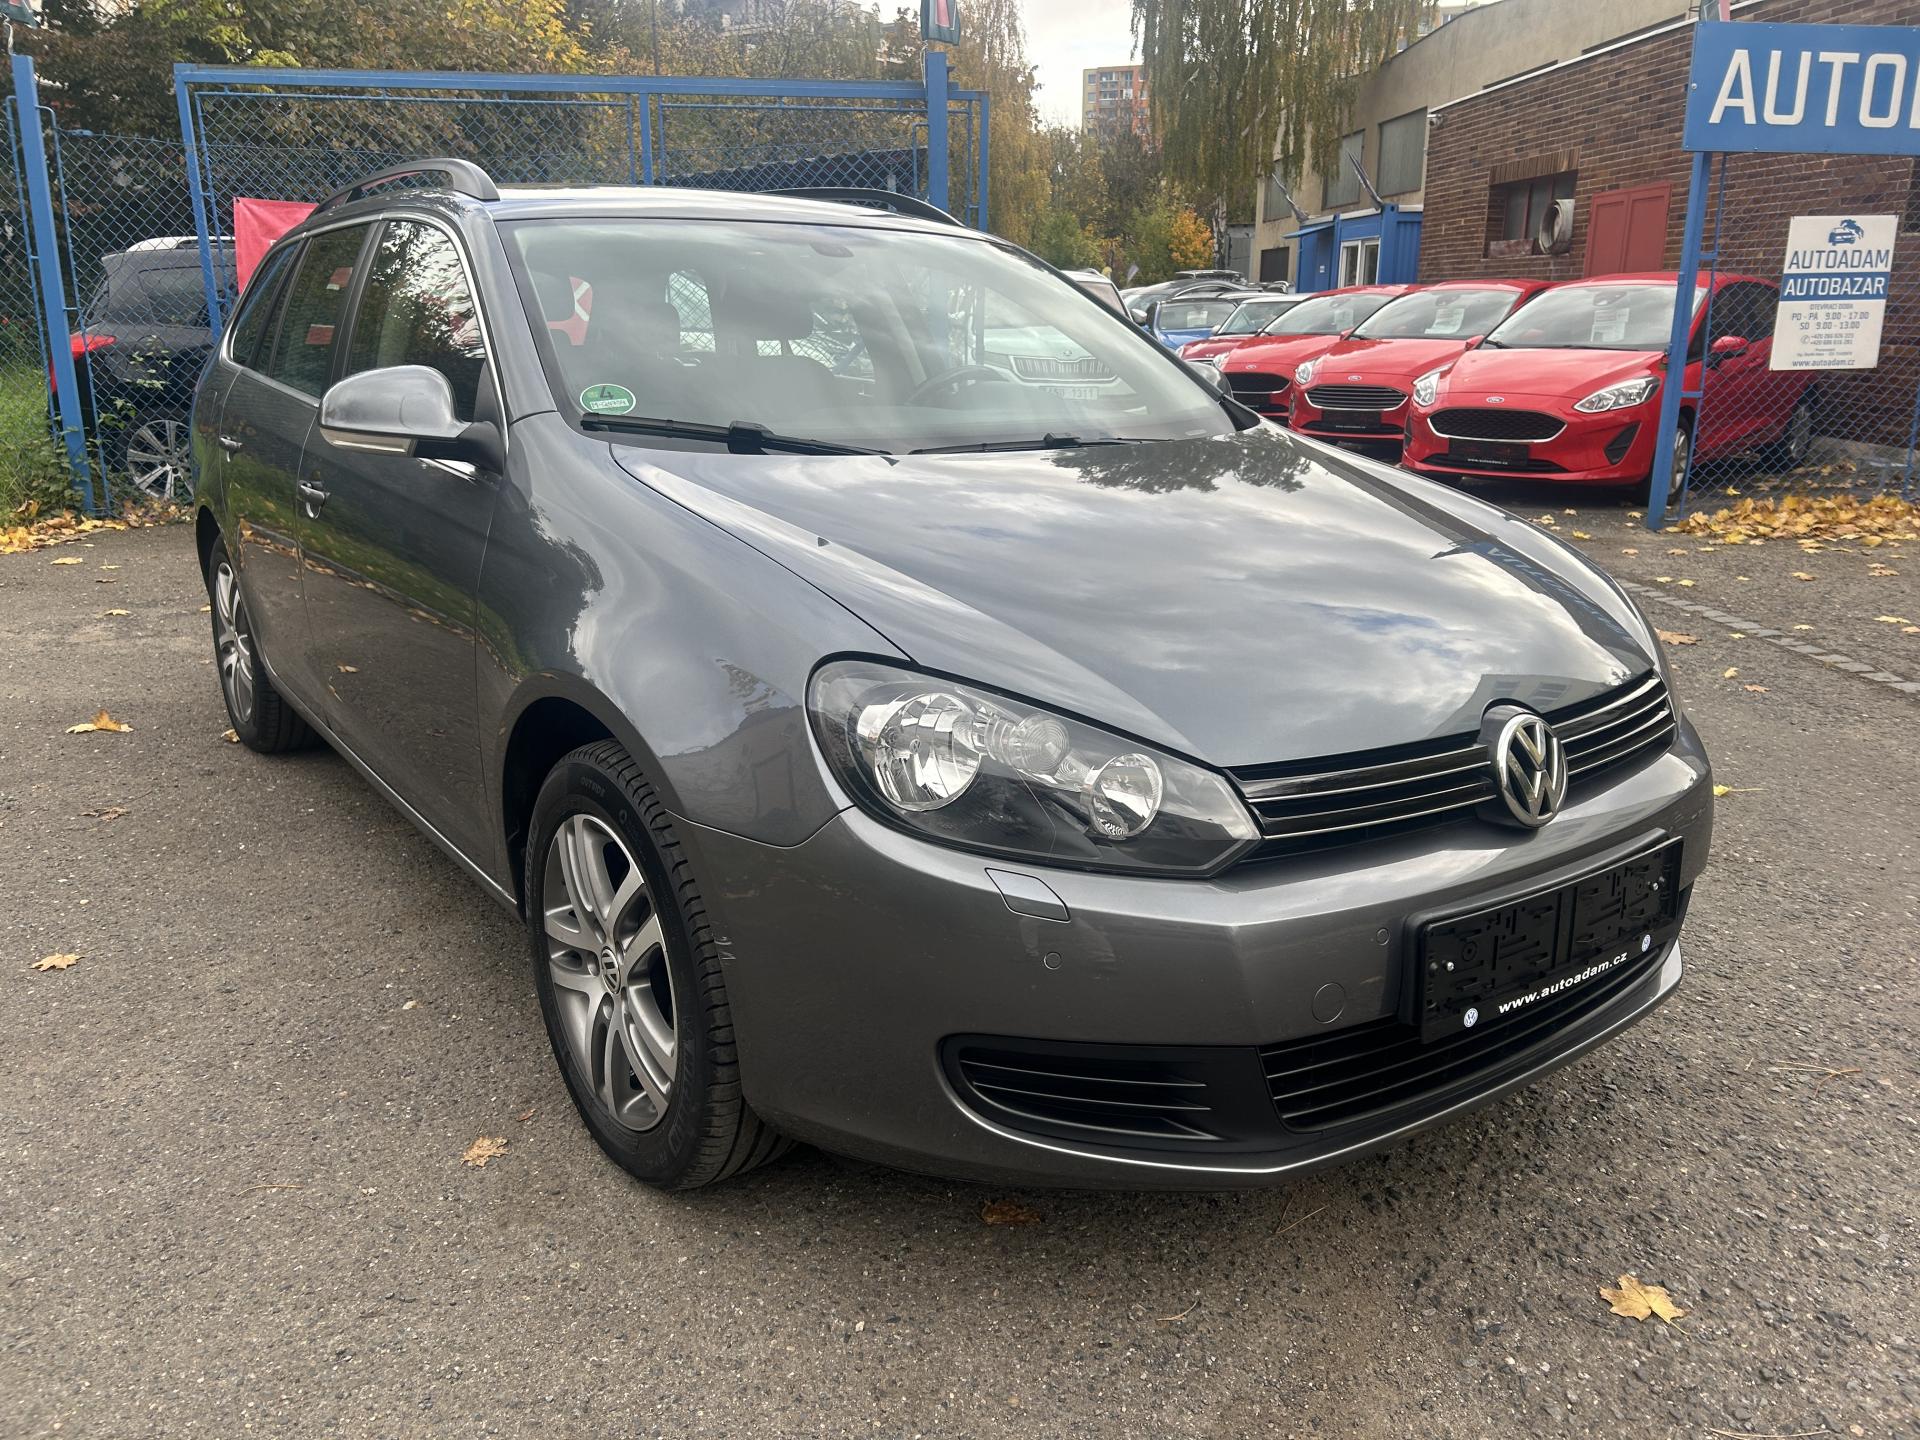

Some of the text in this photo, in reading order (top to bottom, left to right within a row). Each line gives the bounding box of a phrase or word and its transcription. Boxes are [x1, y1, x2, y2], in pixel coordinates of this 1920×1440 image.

[1708, 49, 1920, 129] AUTO
[1788, 249, 1890, 269] AUTOADAM
[1784, 277, 1886, 296] AUTOBAZAR
[1792, 312, 1802, 320] PO
[1792, 358, 1855, 367] www.autoadam.cz
[600, 385, 614, 399] 4
[1499, 951, 1628, 1014] www.autoadam.cz
